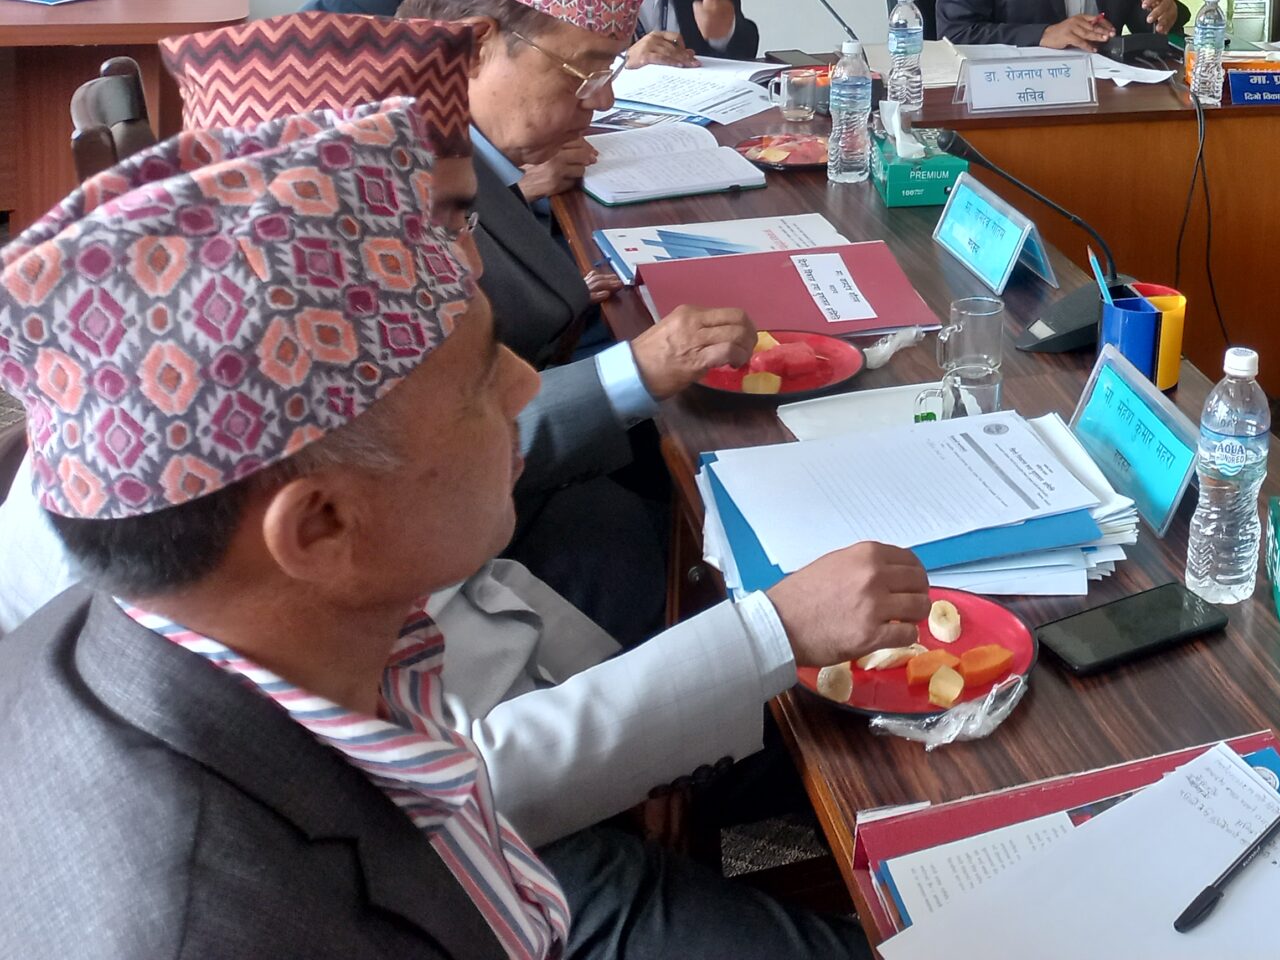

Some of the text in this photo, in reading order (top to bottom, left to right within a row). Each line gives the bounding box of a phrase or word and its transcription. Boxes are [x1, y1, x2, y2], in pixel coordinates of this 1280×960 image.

[984, 63, 1072, 82] डा. रोजनाथ पाण्डे
[1249, 74, 1270, 84] मा.
[1017, 88, 1044, 102] सचिव
[910, 171, 949, 179] PREMIUM
[1217, 443, 1244, 455] AQUA
